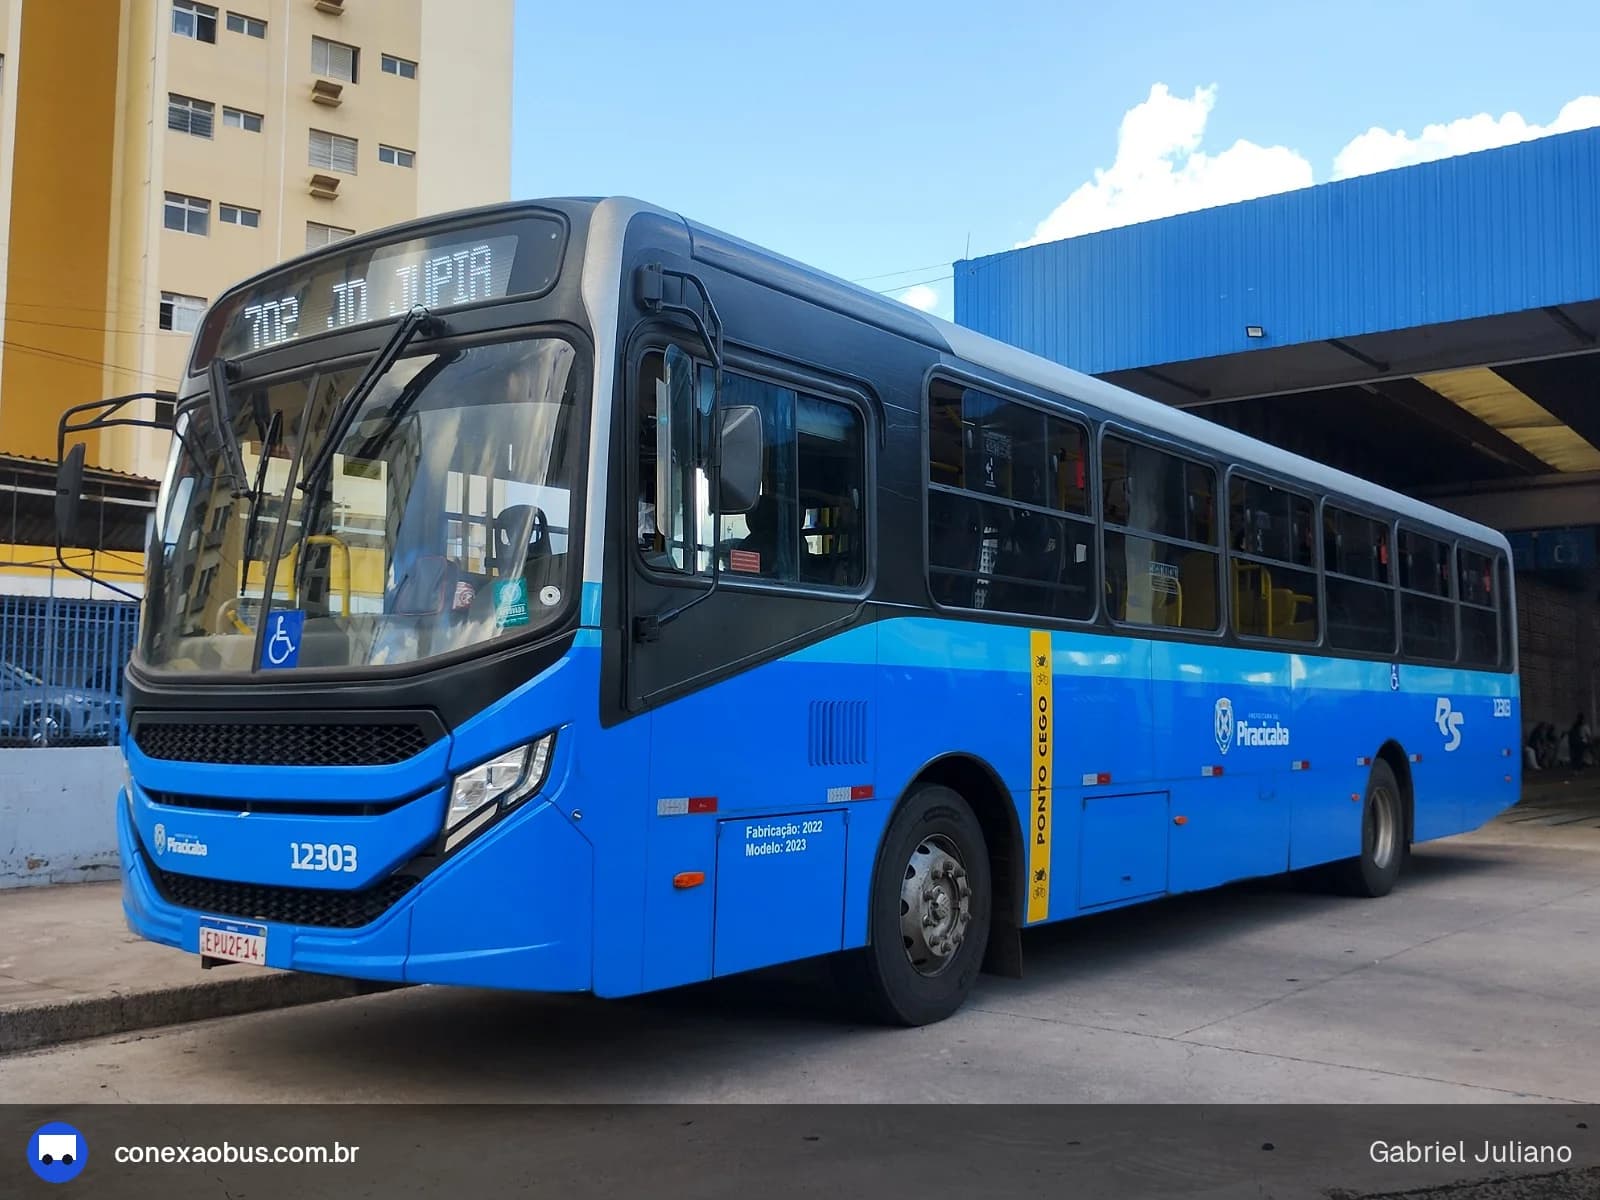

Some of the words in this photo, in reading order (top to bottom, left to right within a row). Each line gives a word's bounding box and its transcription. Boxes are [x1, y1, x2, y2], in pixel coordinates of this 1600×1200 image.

[1038, 695, 1048, 757] CEGO
[1236, 720, 1290, 747] Piracicaba
[1036, 765, 1048, 845] PONTO
[745, 823, 801, 839] Fabricação:
[802, 820, 823, 834] 2022
[167, 836, 208, 857] Piracicaba
[290, 842, 358, 873] 12303
[745, 842, 784, 857] Modelo:
[785, 838, 807, 852] 2023
[206, 931, 258, 960] EPU2F14
